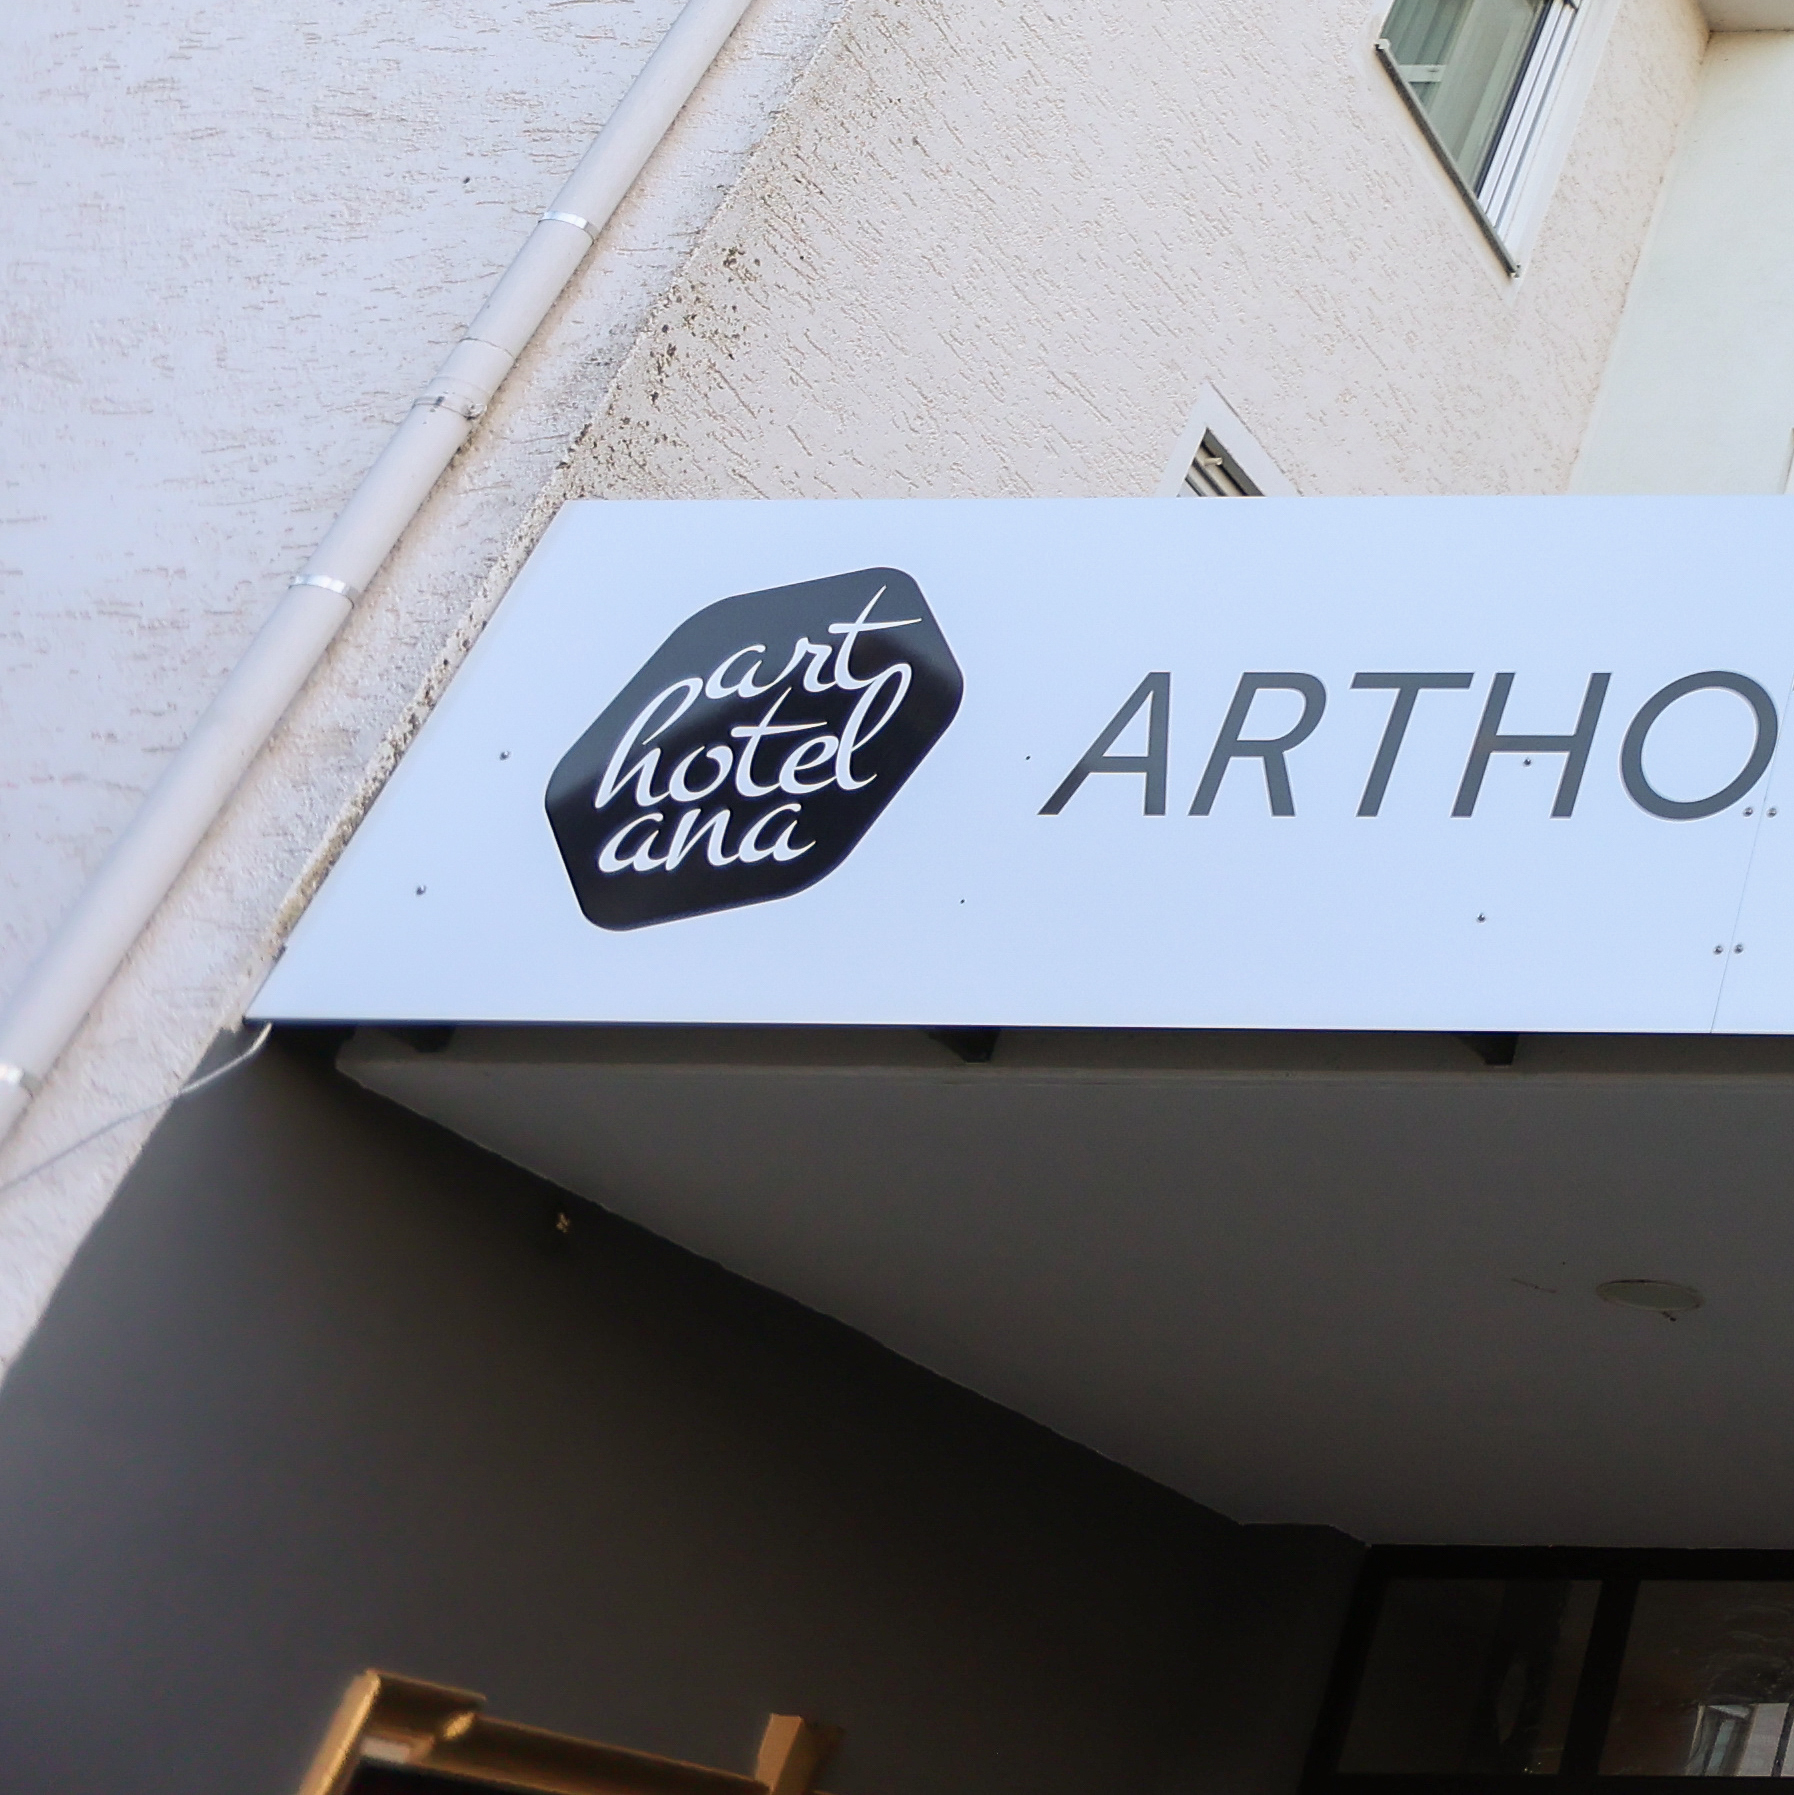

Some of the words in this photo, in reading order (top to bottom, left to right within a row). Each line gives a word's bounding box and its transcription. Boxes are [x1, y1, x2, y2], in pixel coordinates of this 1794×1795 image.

[704, 584, 923, 700] art
[594, 662, 913, 809] hotel
[598, 803, 817, 873] ana
